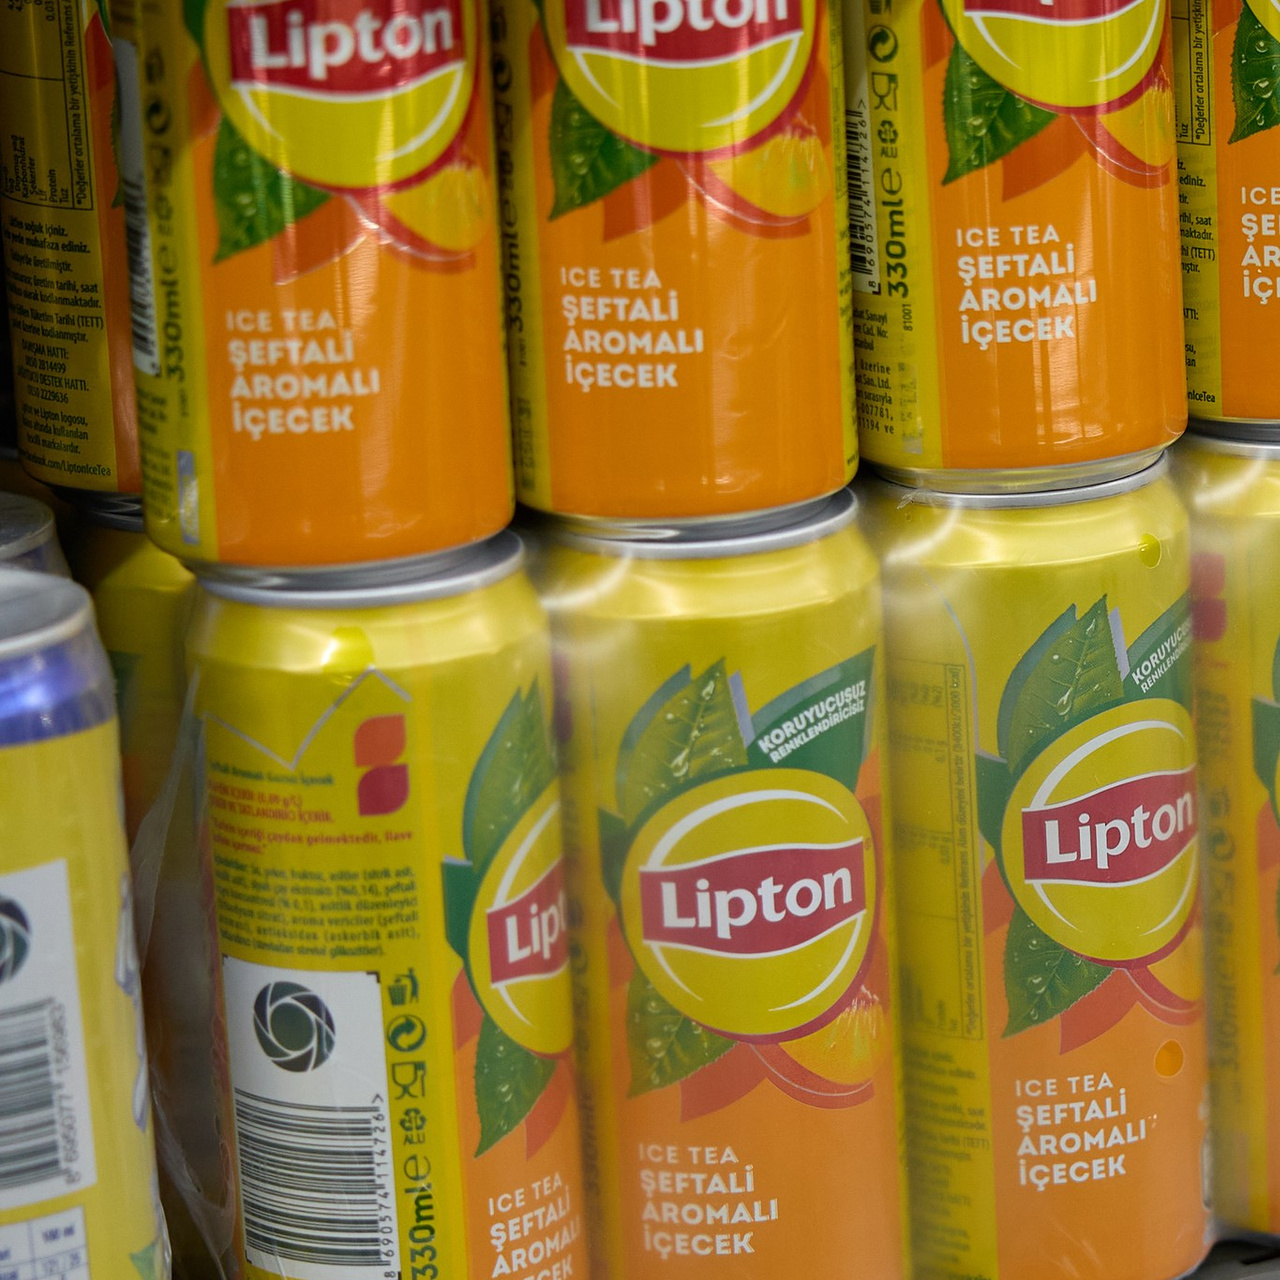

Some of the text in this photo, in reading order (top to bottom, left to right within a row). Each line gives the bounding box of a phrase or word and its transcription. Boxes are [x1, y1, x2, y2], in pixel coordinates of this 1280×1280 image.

[250, 5, 455, 82] Lipton
[956, 224, 1061, 247] ICE TEA
[560, 267, 662, 289] ICE TEA
[957, 242, 1075, 287] ŞEFTALİ
[562, 290, 679, 326] ŞEFTALİ
[958, 279, 1097, 312] AROMALI
[226, 308, 338, 332] ICE TEA
[961, 314, 1075, 351] İÇECEK
[229, 327, 356, 371] ŞEFTALİ
[564, 329, 704, 354] AROMALI
[230, 368, 380, 401] AROMALI
[565, 354, 678, 393] İÇECEK
[231, 399, 356, 440] İÇECEK
[757, 680, 866, 754] KORUYUCUSUZ
[769, 698, 865, 764] RENKLENDİRİCİSİZ
[1044, 792, 1193, 870] Lipton
[660, 867, 853, 940] Lipton
[1014, 1072, 1115, 1098] ICE TEA
[1016, 1087, 1128, 1134] ŞEFTALİ
[638, 1143, 740, 1165] ICE TEA
[1016, 1118, 1147, 1157] AROMALI
[639, 1164, 756, 1198] ŞEFTALİ
[1018, 1154, 1127, 1193] İÇECEK
[488, 1170, 564, 1218] ICE TEA
[641, 1198, 779, 1226] AROMALI
[489, 1185, 572, 1254] ŞEFTALİ
[643, 1225, 756, 1261] İÇECEK
